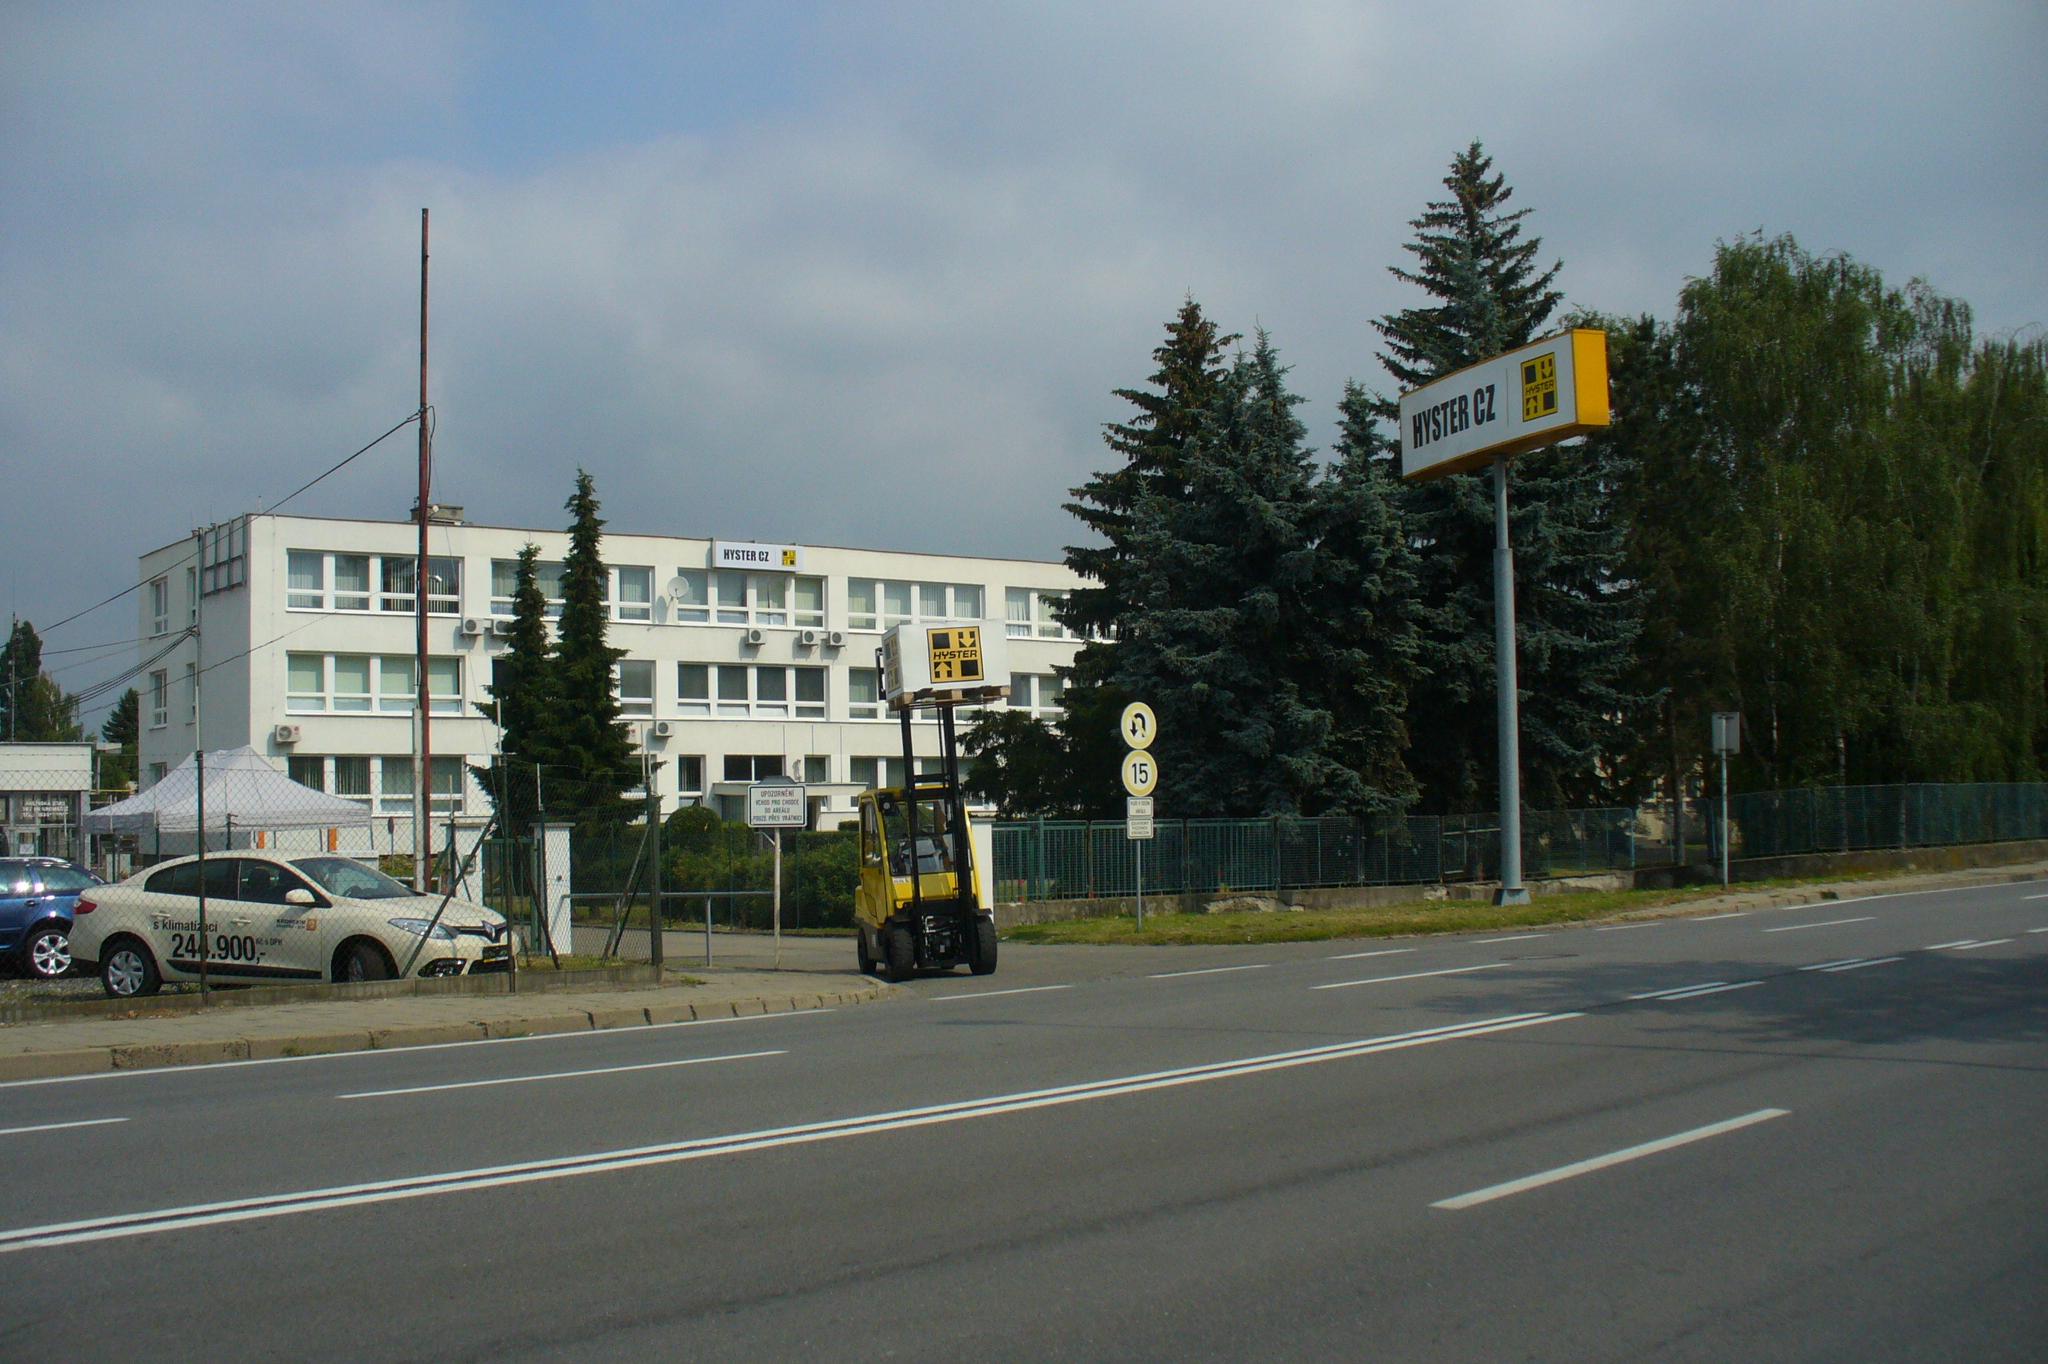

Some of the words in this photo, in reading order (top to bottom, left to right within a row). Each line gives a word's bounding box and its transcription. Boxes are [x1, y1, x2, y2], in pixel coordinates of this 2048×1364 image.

[1526, 380, 1554, 395] HYSTER
[1412, 394, 1469, 449] HYSTER
[1473, 384, 1496, 426] CZ
[724, 549, 757, 561] HYSTER
[758, 551, 769, 562] CZ
[933, 649, 978, 660] HYSTER
[1131, 763, 1148, 784] 15
[153, 921, 159, 930] s
